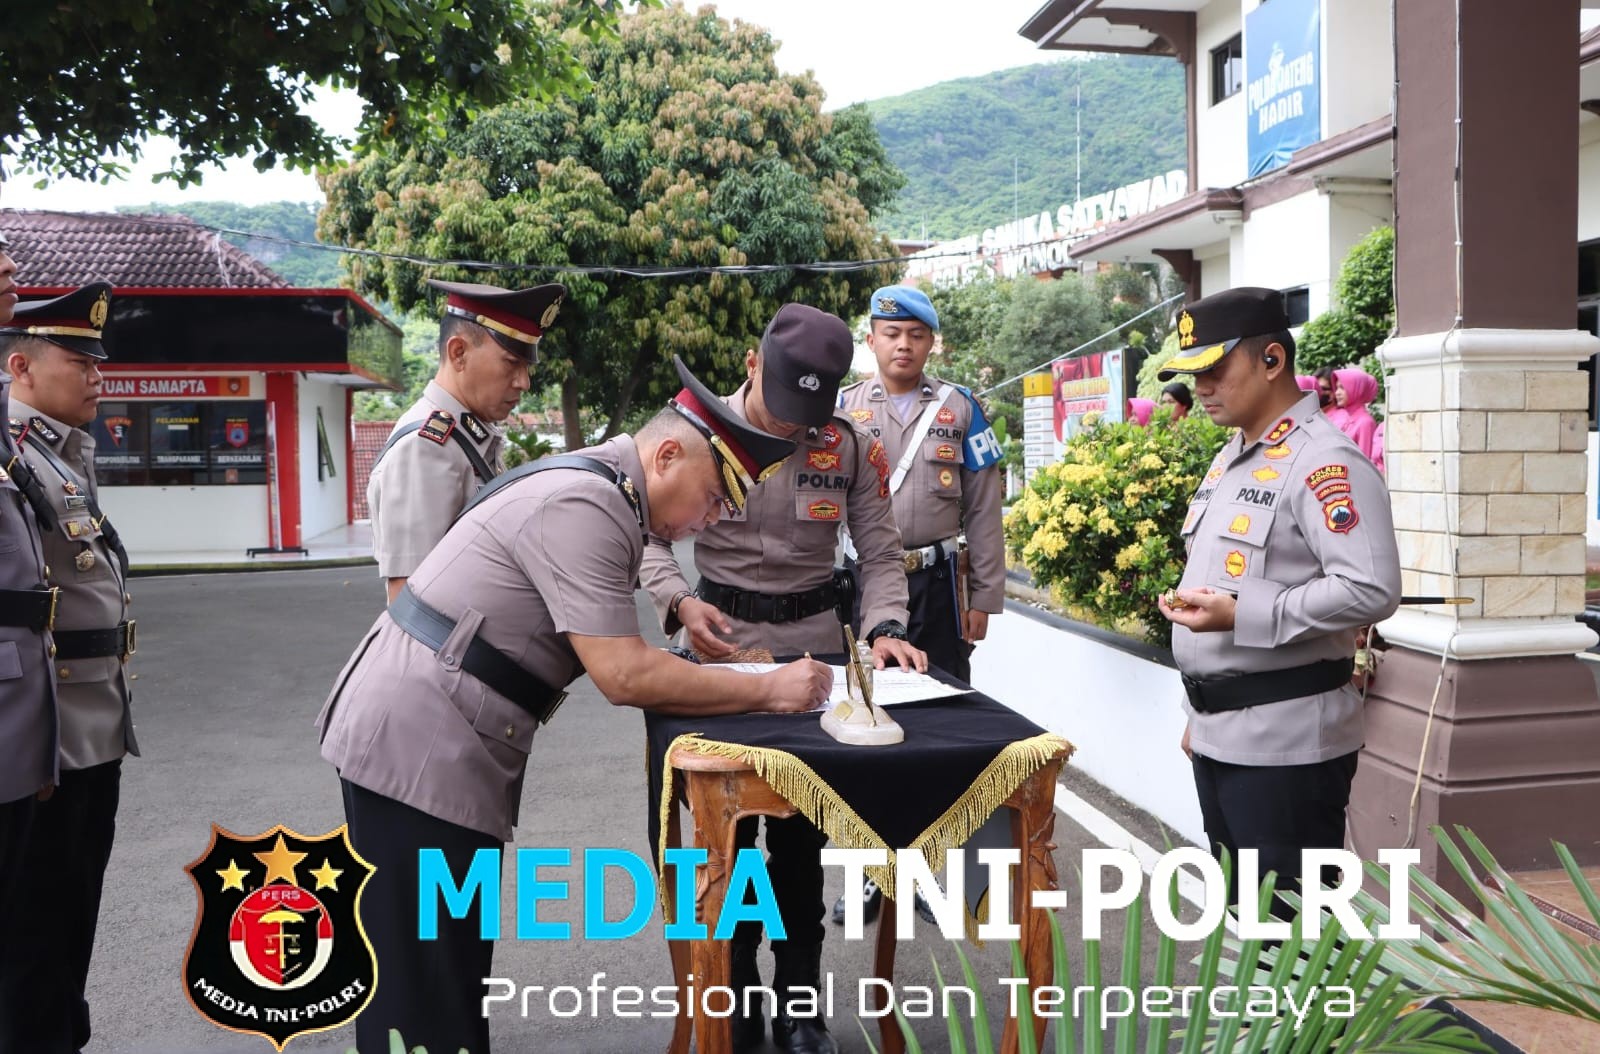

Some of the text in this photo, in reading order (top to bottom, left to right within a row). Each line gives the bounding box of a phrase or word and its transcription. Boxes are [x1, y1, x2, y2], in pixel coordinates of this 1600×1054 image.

[1259, 90, 1304, 135] HADIR
[139, 380, 206, 394] SAMAPTA
[928, 427, 963, 440] POLRI
[797, 473, 849, 490] POLRI
[1236, 488, 1276, 507] POLRI
